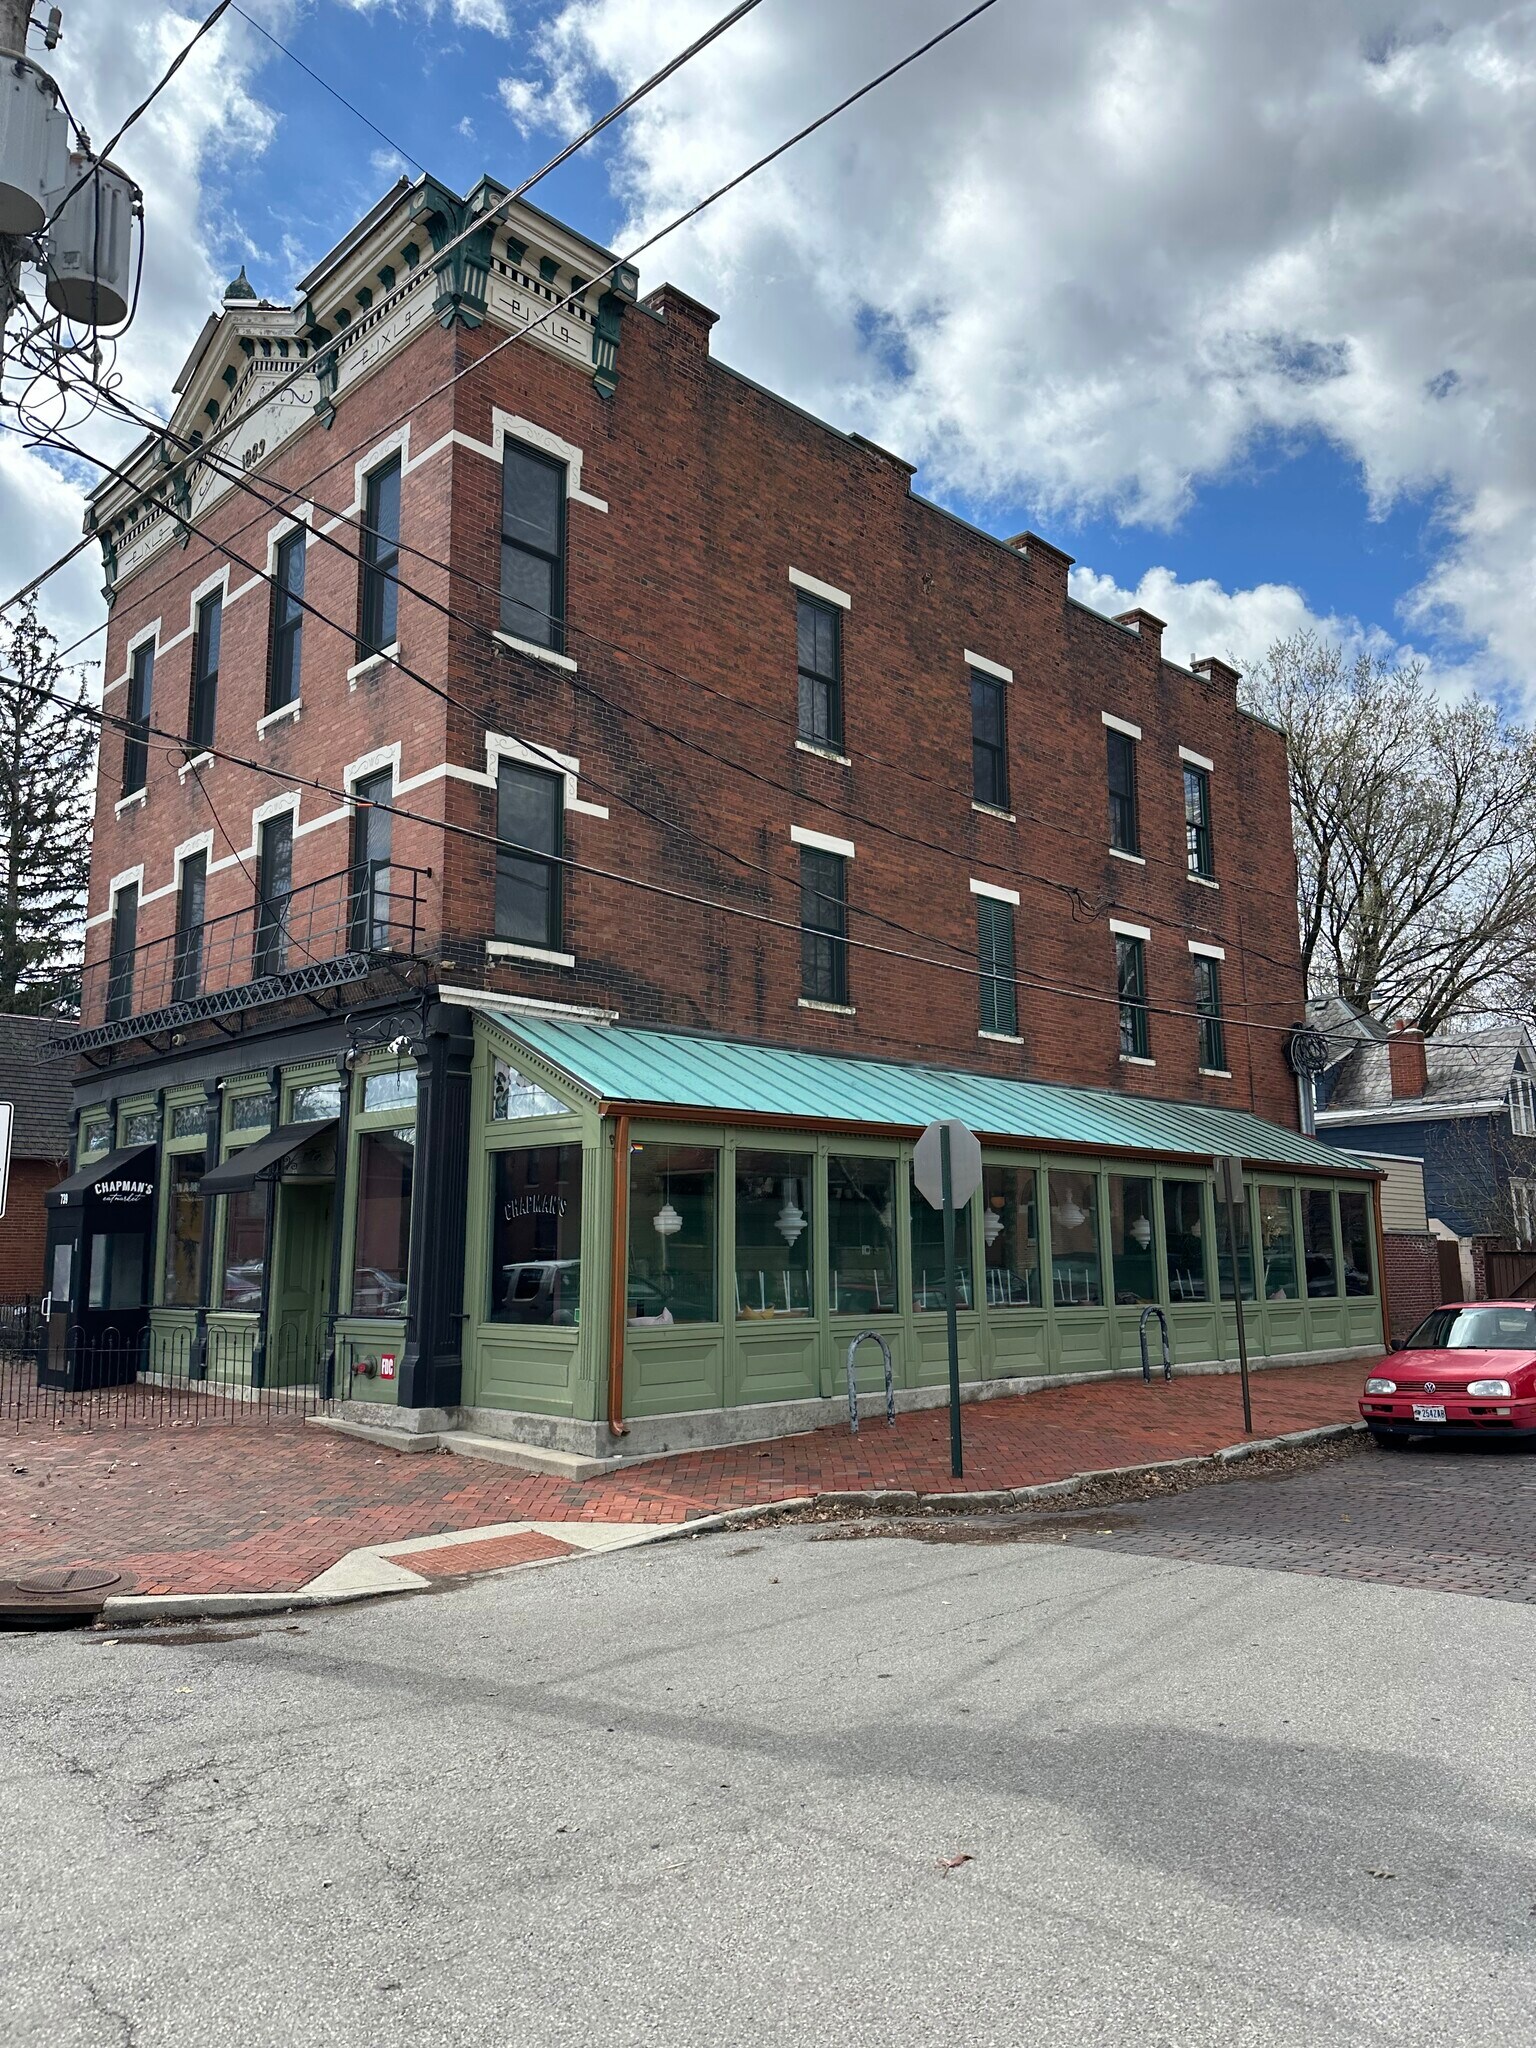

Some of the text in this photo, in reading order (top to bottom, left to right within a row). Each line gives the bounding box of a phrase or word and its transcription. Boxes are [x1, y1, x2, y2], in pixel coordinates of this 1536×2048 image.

[242, 438, 266, 469] 1889
[94, 1180, 154, 1195] CHAPMAN'S
[504, 1194, 567, 1221] CHAPMAN'S
[381, 1358, 394, 1375] FDC
